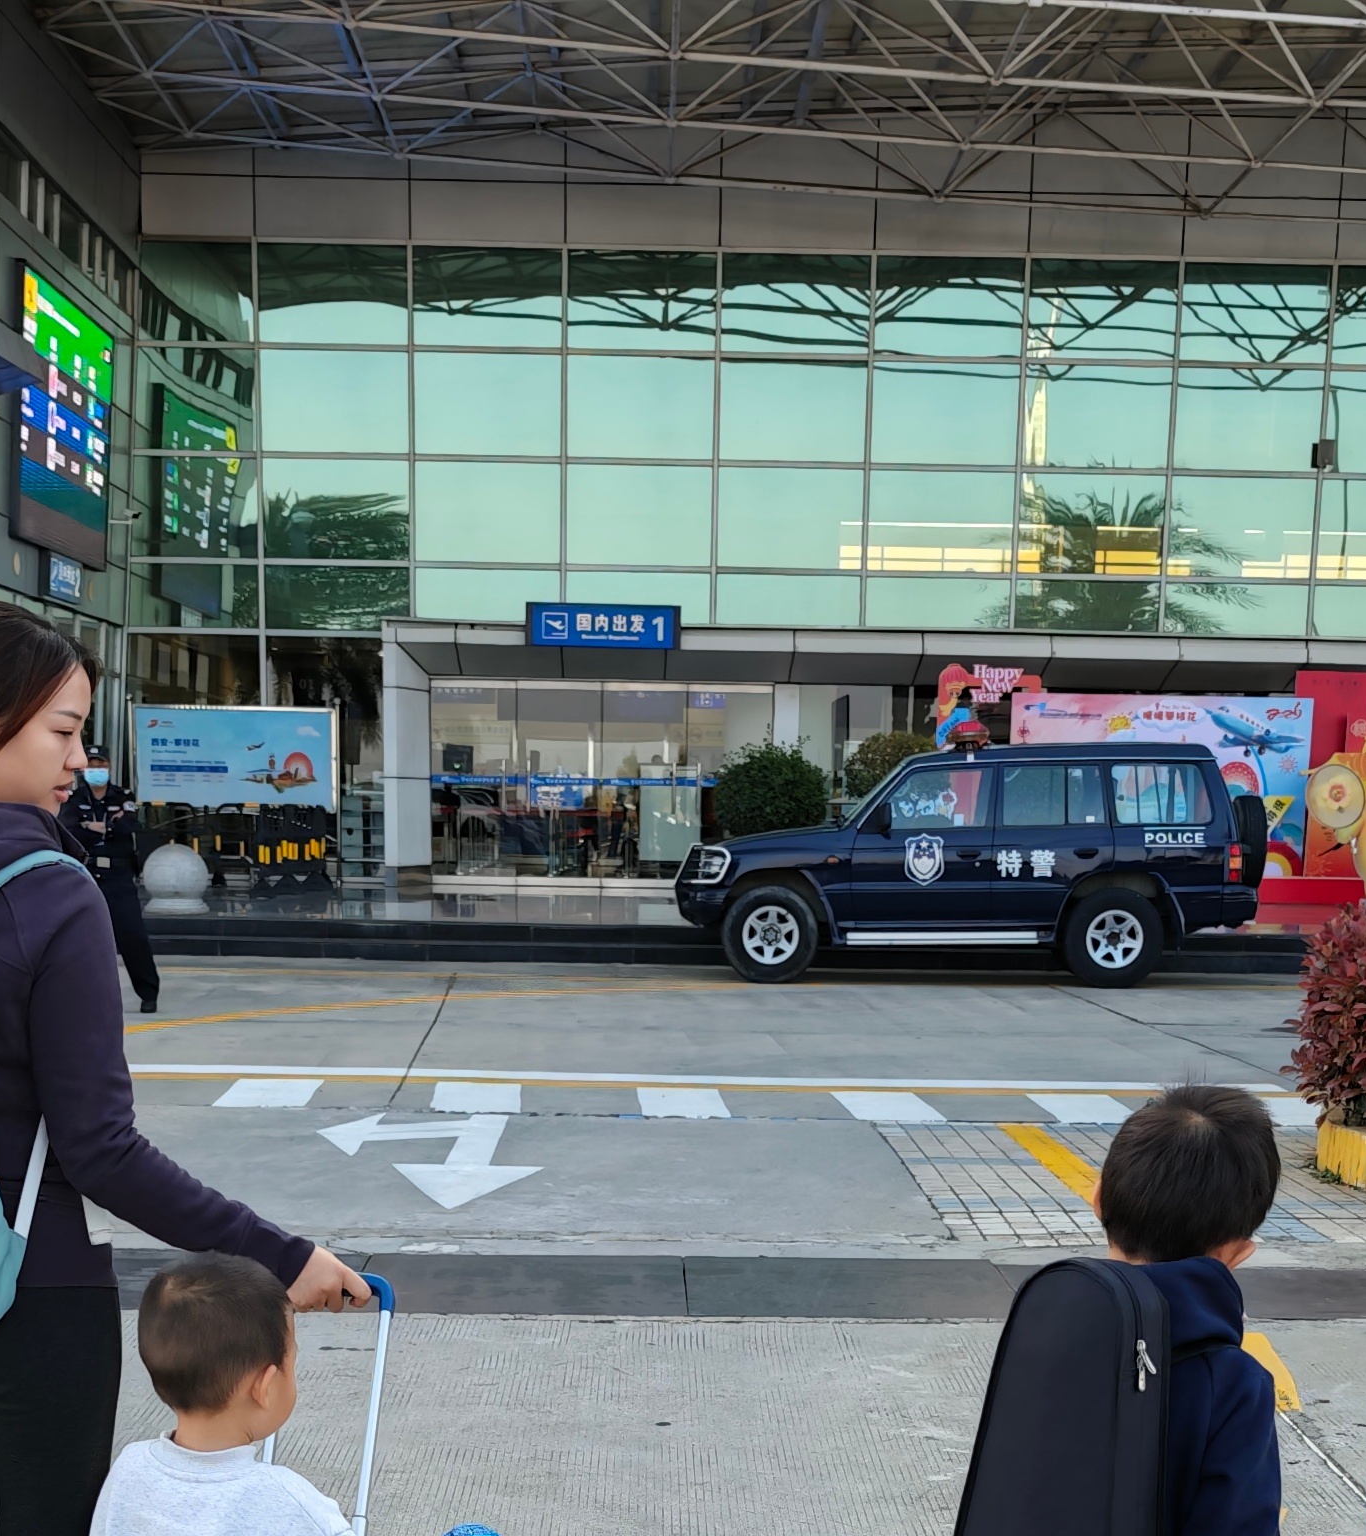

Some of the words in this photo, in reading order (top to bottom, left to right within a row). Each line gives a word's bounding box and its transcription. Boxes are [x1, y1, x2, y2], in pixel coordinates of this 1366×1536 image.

[576, 613, 646, 634] 国内出发
[652, 616, 665, 642] 1
[973, 664, 1025, 684] Happy
[981, 679, 1017, 693] New
[969, 689, 1004, 703] Year
[1145, 832, 1205, 844] POLICE
[997, 850, 1056, 877] 特警
